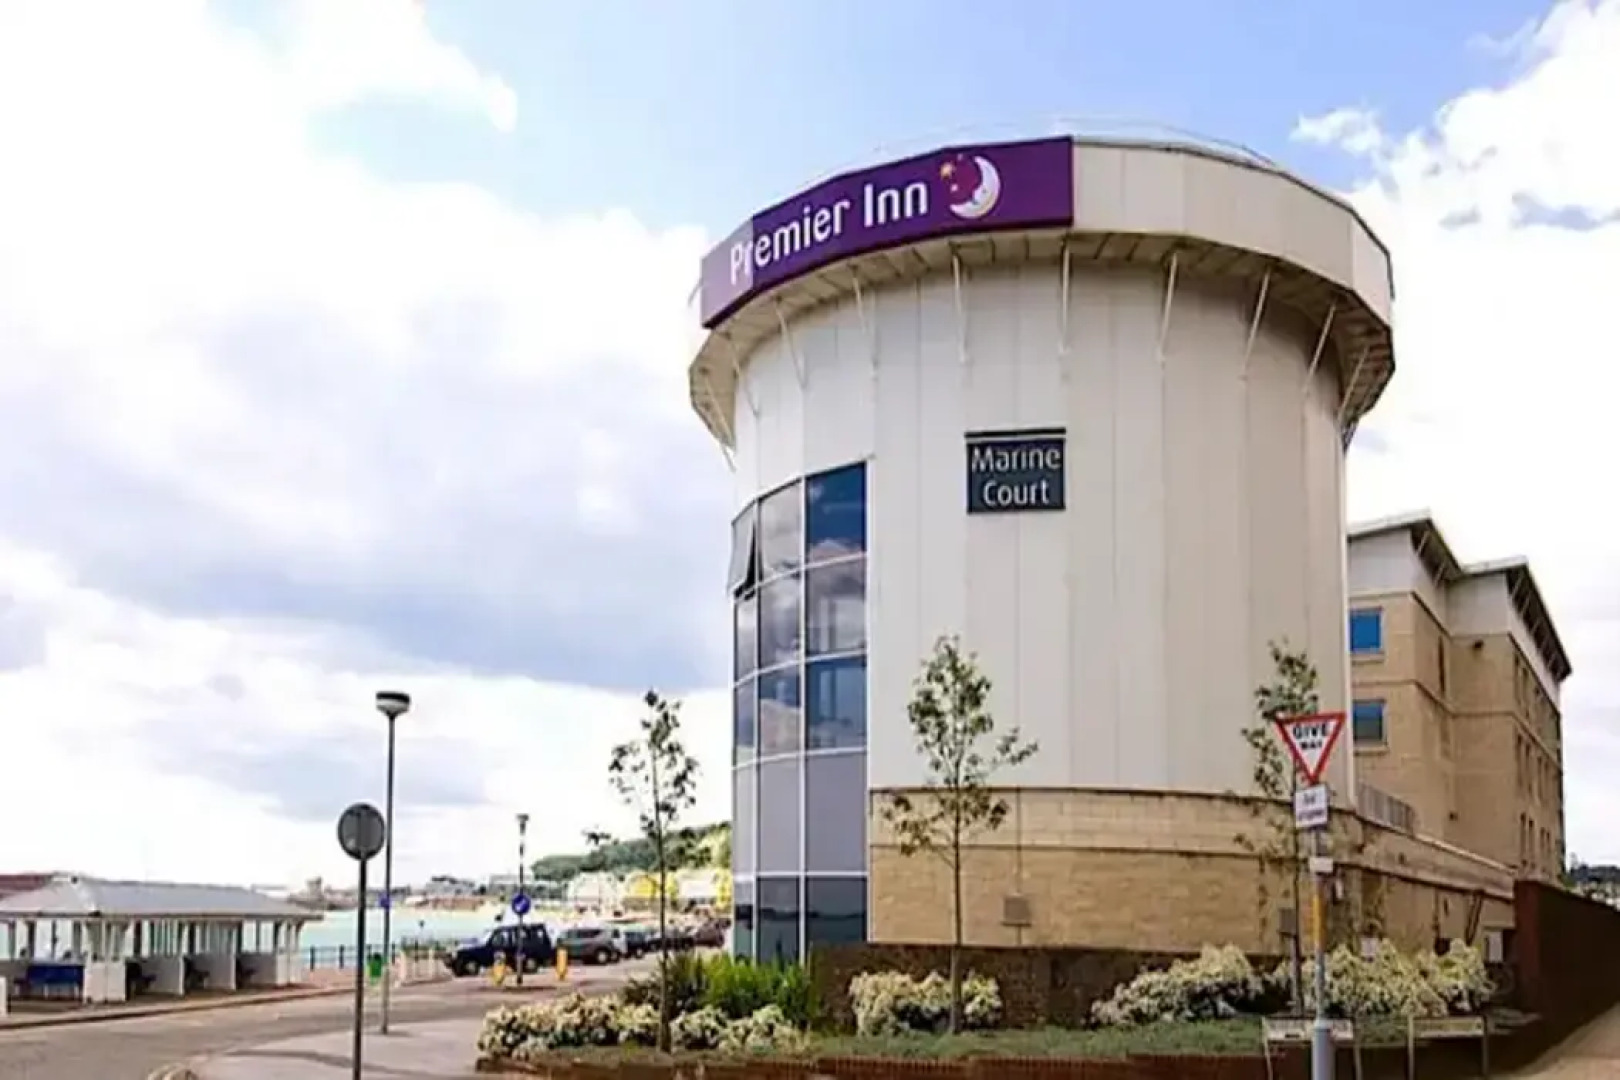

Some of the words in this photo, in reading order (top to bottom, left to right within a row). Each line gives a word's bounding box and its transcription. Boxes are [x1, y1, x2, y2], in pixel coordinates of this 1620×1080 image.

[731, 199, 851, 286] Premier
[863, 181, 928, 228] Inn
[971, 446, 1061, 472] Marine
[983, 479, 1050, 507] Court
